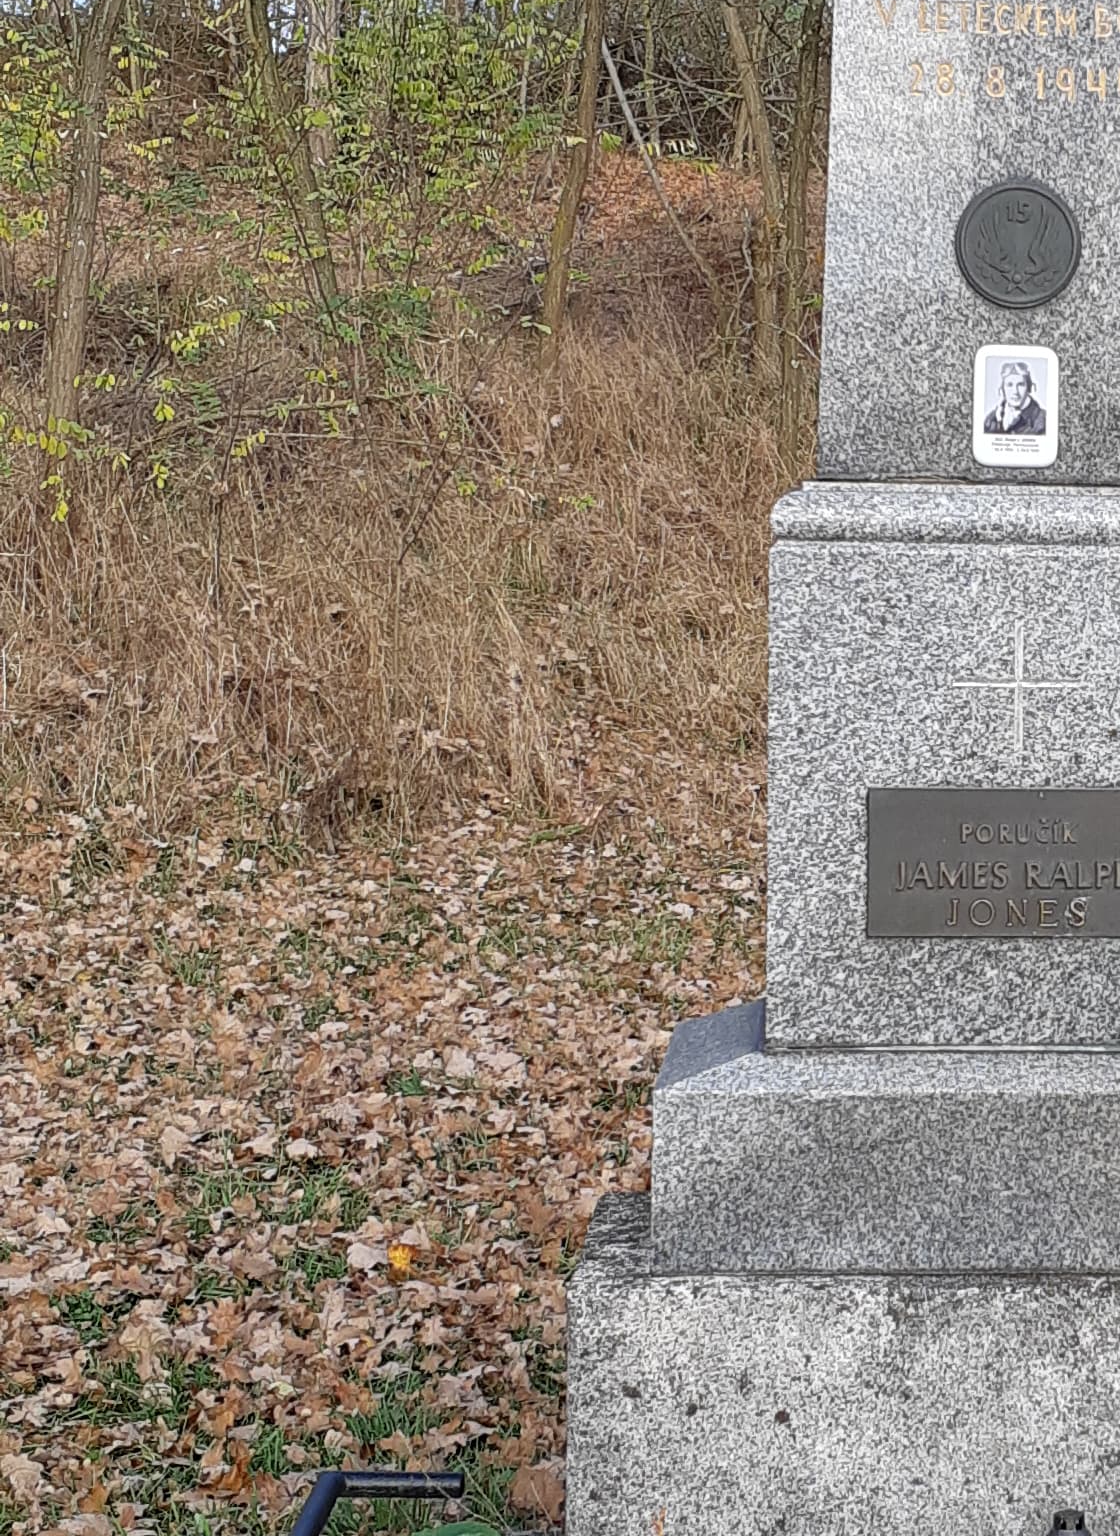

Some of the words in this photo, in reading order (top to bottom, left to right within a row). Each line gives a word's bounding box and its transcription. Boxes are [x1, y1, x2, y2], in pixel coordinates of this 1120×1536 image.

[959, 818, 1078, 844] PORUČÍK
[896, 861, 1010, 891] JAMES
[946, 897, 1090, 928] JONES
